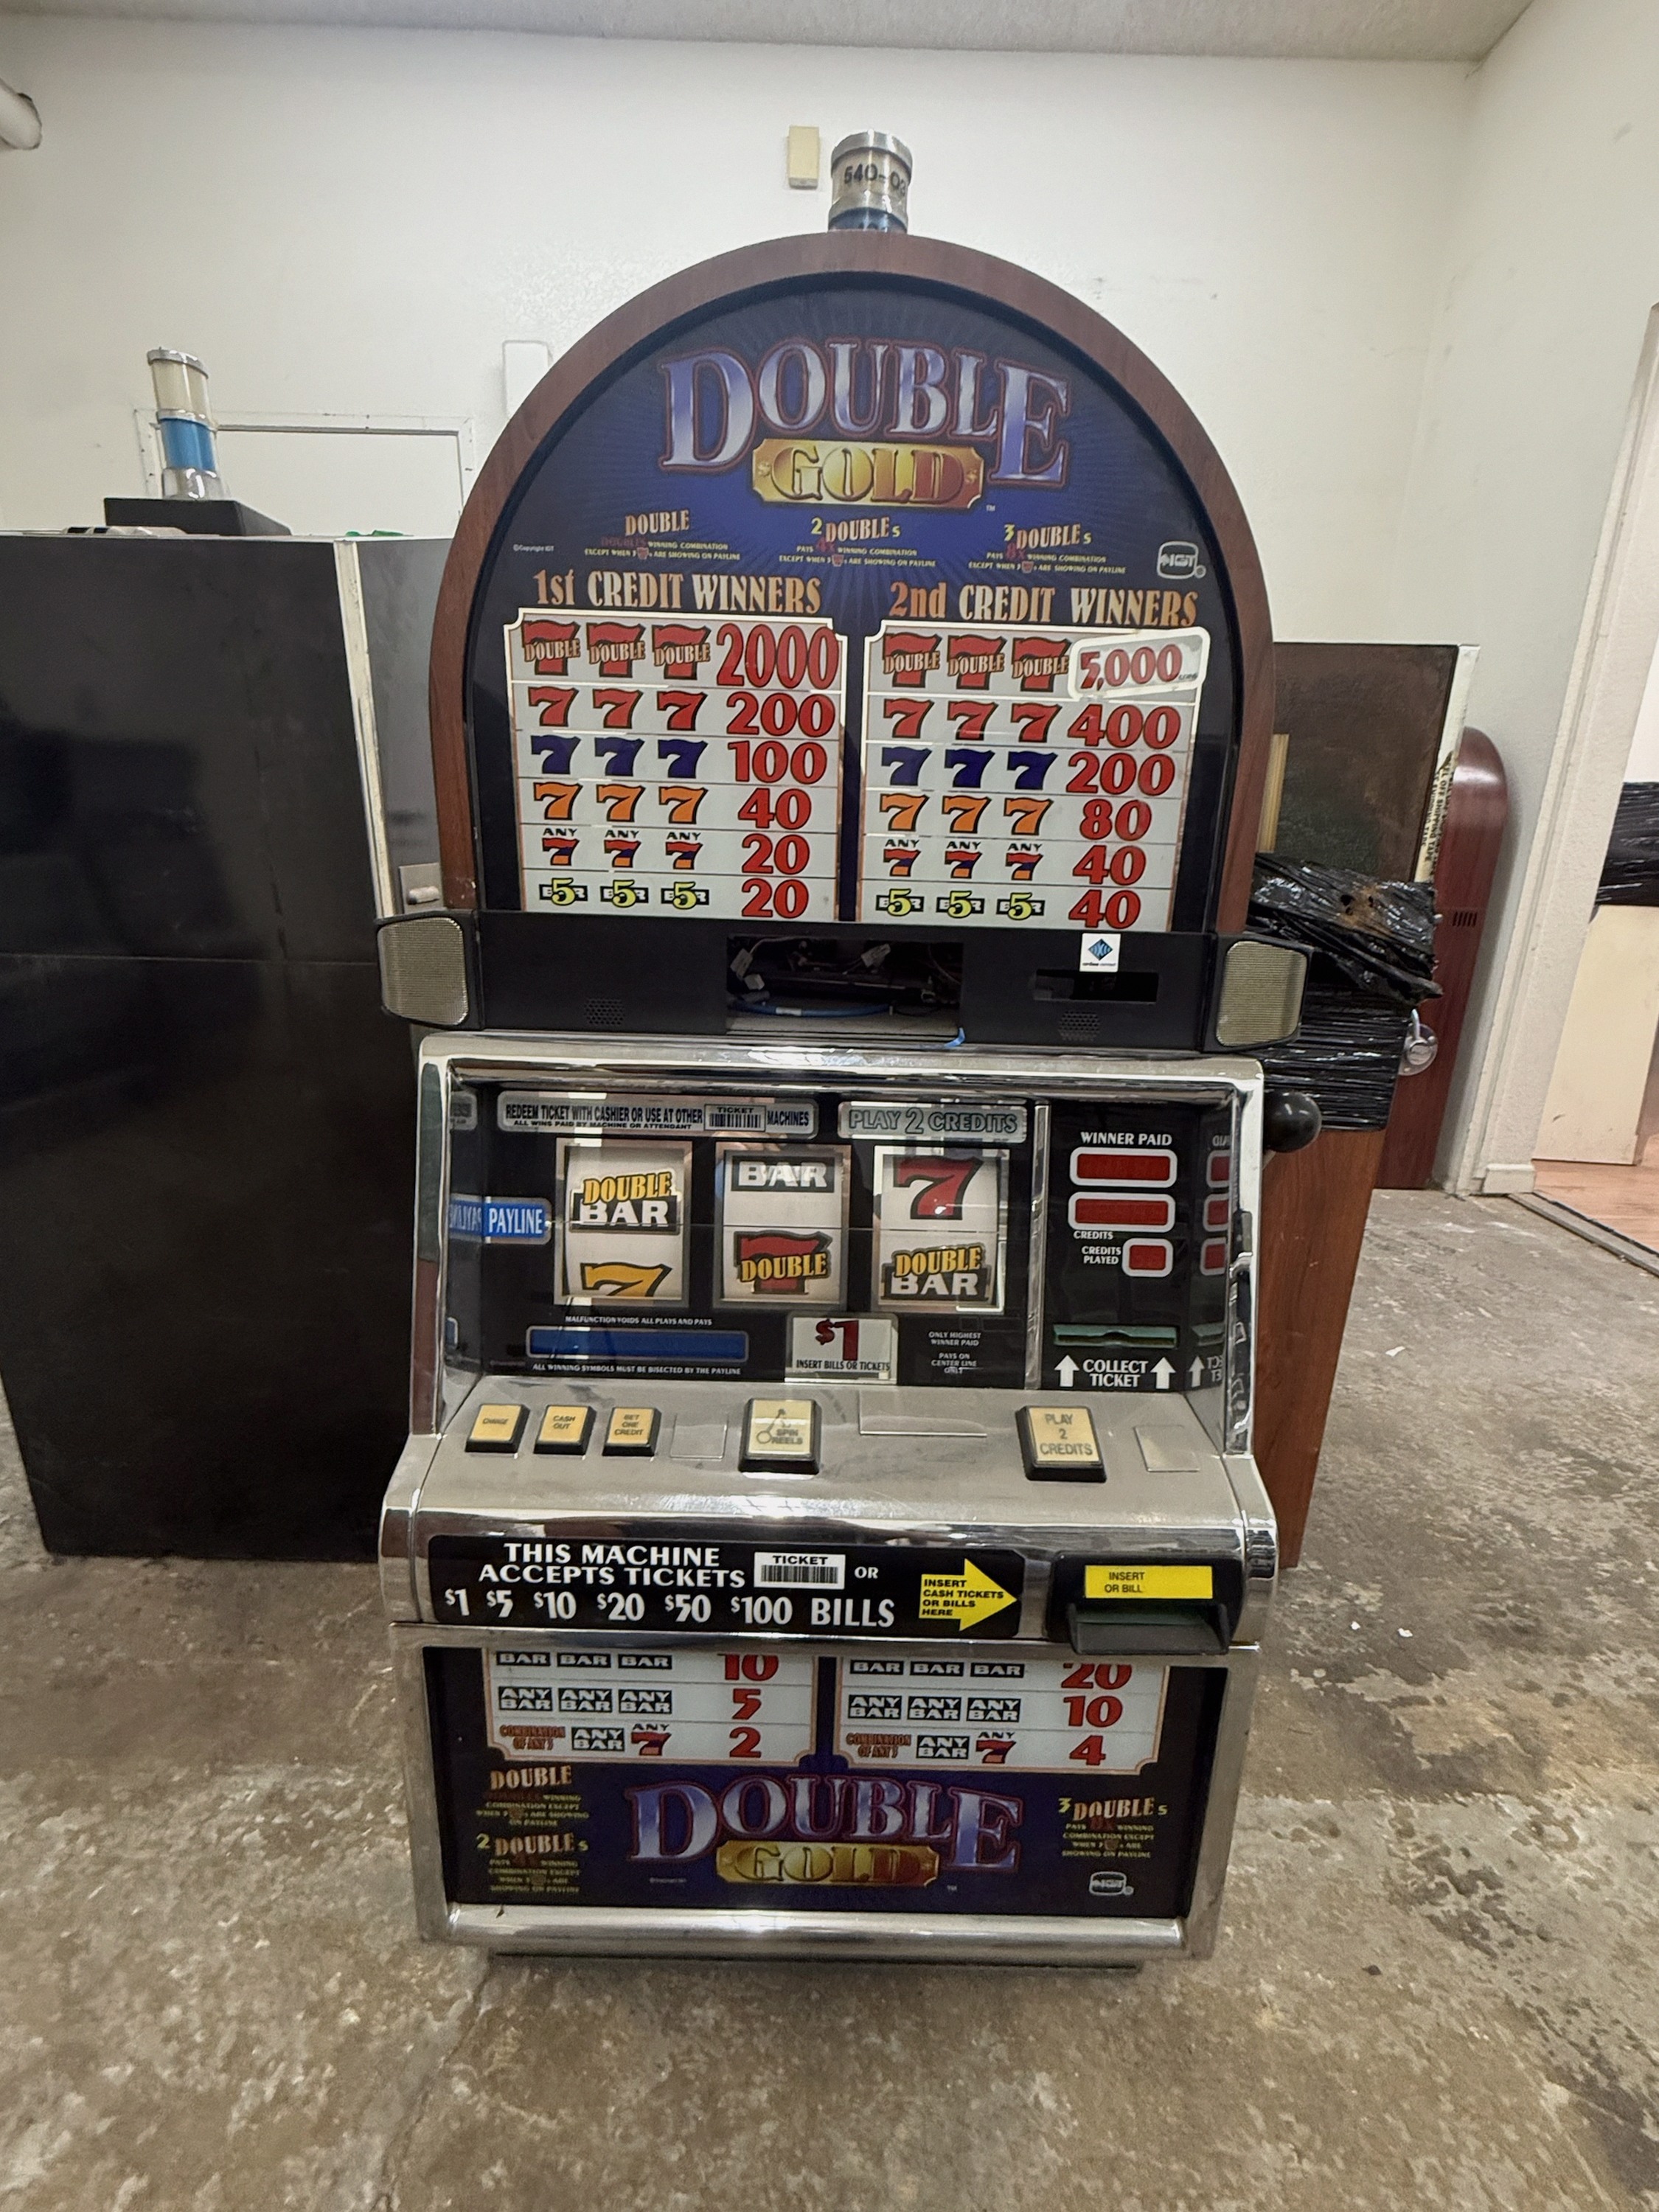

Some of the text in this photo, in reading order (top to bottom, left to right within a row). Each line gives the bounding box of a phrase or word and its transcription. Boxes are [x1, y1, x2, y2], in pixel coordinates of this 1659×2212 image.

[661, 337, 1069, 488] DOUBLE
[770, 447, 966, 502] GOLD
[625, 509, 690, 536] DOUBLE
[811, 518, 822, 535] 2
[826, 516, 890, 542] DOUBLE
[1004, 524, 1015, 541] 3
[1017, 523, 1081, 549] DOUBLE
[680, 541, 728, 550] COMBINATION
[869, 549, 917, 557] COMBINATION
[1059, 554, 1106, 563] COMBINATION
[533, 568, 821, 614] 1st CREDIT WINNERS
[889, 580, 1198, 627] 2nd CREDIT WINNERS
[524, 622, 840, 691] DOUBLE DOUBLE DOUBLE 2000
[1079, 644, 1183, 692] 5,000
[726, 691, 836, 737] 200
[1067, 703, 1181, 749] 400
[727, 740, 827, 785] 100
[1066, 751, 1176, 796] 200
[737, 787, 812, 830] 40
[1079, 799, 1152, 841] 80
[741, 833, 810, 875] 20
[1072, 844, 1147, 886] 40
[741, 877, 810, 919] 20
[1068, 889, 1141, 929] 40
[506, 1103, 539, 1119] REDEEM
[540, 1105, 570, 1121] TICKET
[571, 1105, 592, 1120] WITH
[594, 1105, 630, 1122] CASHIER
[631, 1107, 643, 1122] OR
[644, 1108, 661, 1123] USE
[664, 1107, 674, 1123] AT
[675, 1108, 703, 1124] OTHER
[767, 1110, 809, 1126] MACHINES
[849, 1105, 1018, 1134] PLAY 2 CREDITS
[1080, 1131, 1172, 1147] WINNER PAID
[582, 1171, 672, 1205] DOUBLE
[738, 1161, 827, 1188] BAR
[488, 1207, 543, 1234] PAYLINE
[578, 1200, 669, 1227] BAR
[1074, 1230, 1113, 1241] CREDITS
[894, 1246, 982, 1278] DOUBLE
[1081, 1245, 1121, 1256] CREDITS
[1083, 1254, 1119, 1265] PLAYED
[740, 1253, 827, 1282] DOUBLE
[891, 1273, 981, 1297] BAR
[815, 1318, 859, 1361] $1
[712, 1367, 741, 1375] PAYLINE
[796, 1360, 891, 1371] INSERT BILLS OR TICKETS
[1082, 1357, 1148, 1374] COLLECT
[1091, 1373, 1139, 1388] TICKET
[776, 1428, 799, 1436] SPIN
[1044, 1413, 1074, 1425] PLAY
[1059, 1428, 1068, 1439] 2
[1040, 1442, 1093, 1455] CREDITS
[504, 1543, 720, 1567] THIS MACHINE
[478, 1555, 878, 1588] ACCEPTS TICKETS TICKET OR
[924, 1579, 967, 1587] INSERT
[1108, 1572, 1145, 1580] INSERT
[957, 1590, 1004, 1599] TICKETS
[1104, 1584, 1143, 1593] OR BILL
[445, 1587, 895, 1627] $1 $5 $10 $20 $50 $100 BILLS
[942, 1599, 976, 1607] BILLS
[717, 1653, 779, 1682] 10
[731, 1688, 762, 1721] 5
[1062, 1694, 1123, 1728] 10
[728, 1726, 762, 1759] 2
[1069, 1734, 1107, 1767] 4
[490, 1764, 572, 1790] DOUBLE
[1058, 1797, 1071, 1813] 3
[1073, 1797, 1155, 1821] DOUBLE
[625, 1773, 1025, 1873] DOUBLE
[476, 1832, 490, 1849] 2
[495, 1832, 574, 1857] DOUBLE
[736, 1846, 920, 1882] GOLD
